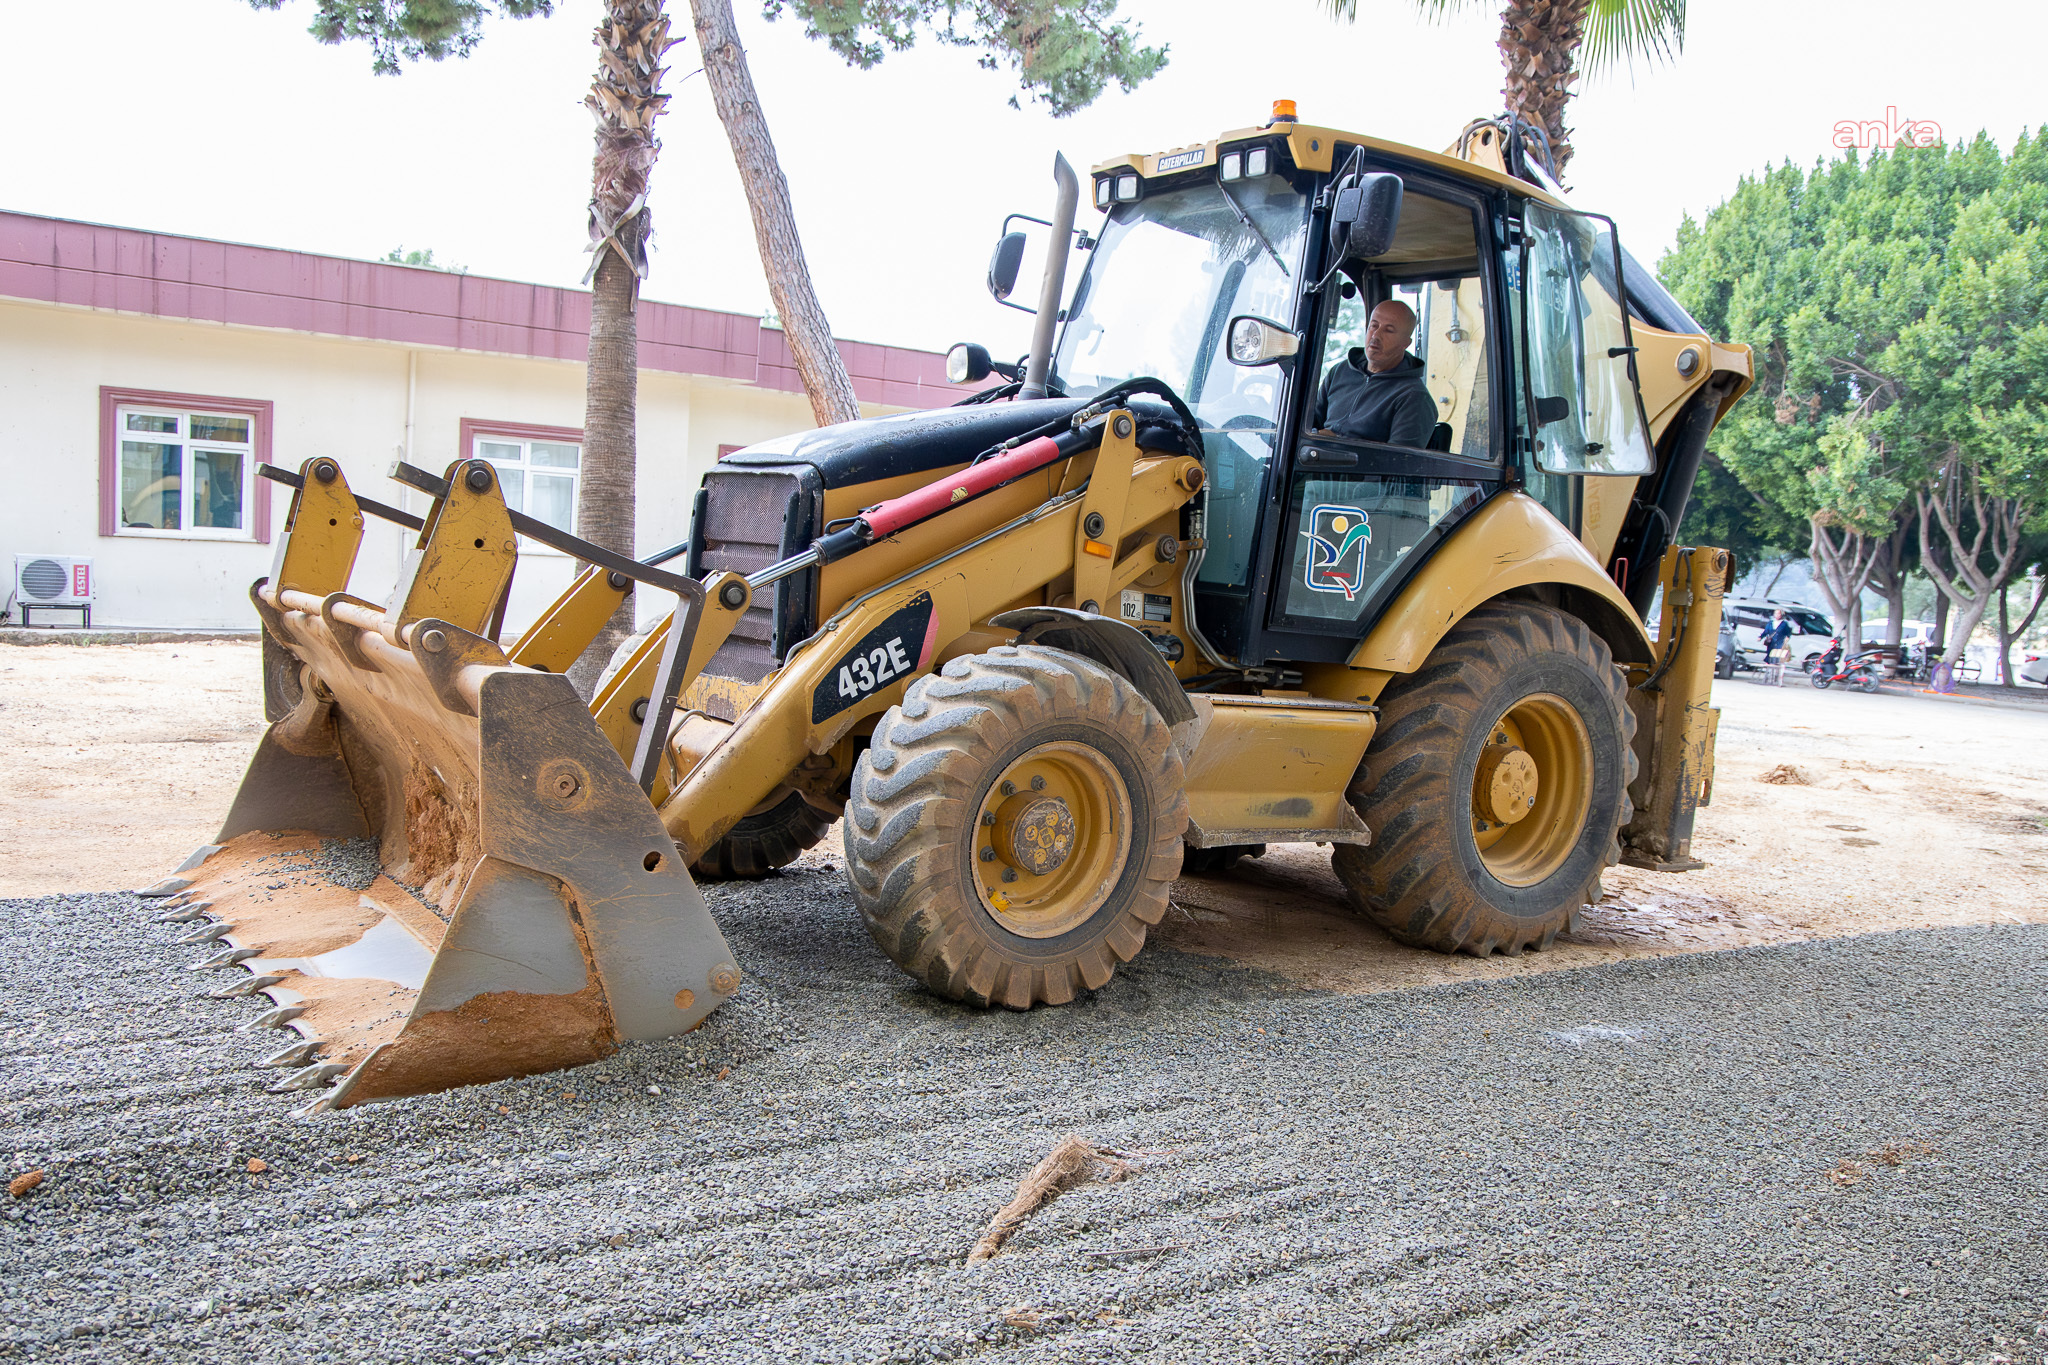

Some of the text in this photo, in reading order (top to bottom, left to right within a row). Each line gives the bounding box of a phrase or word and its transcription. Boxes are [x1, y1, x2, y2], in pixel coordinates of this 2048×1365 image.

[1158, 150, 1204, 171] CATERPILLAR
[76, 565, 87, 597] VESTEL
[1122, 602, 1136, 618] 102
[838, 636, 911, 699] 432E
